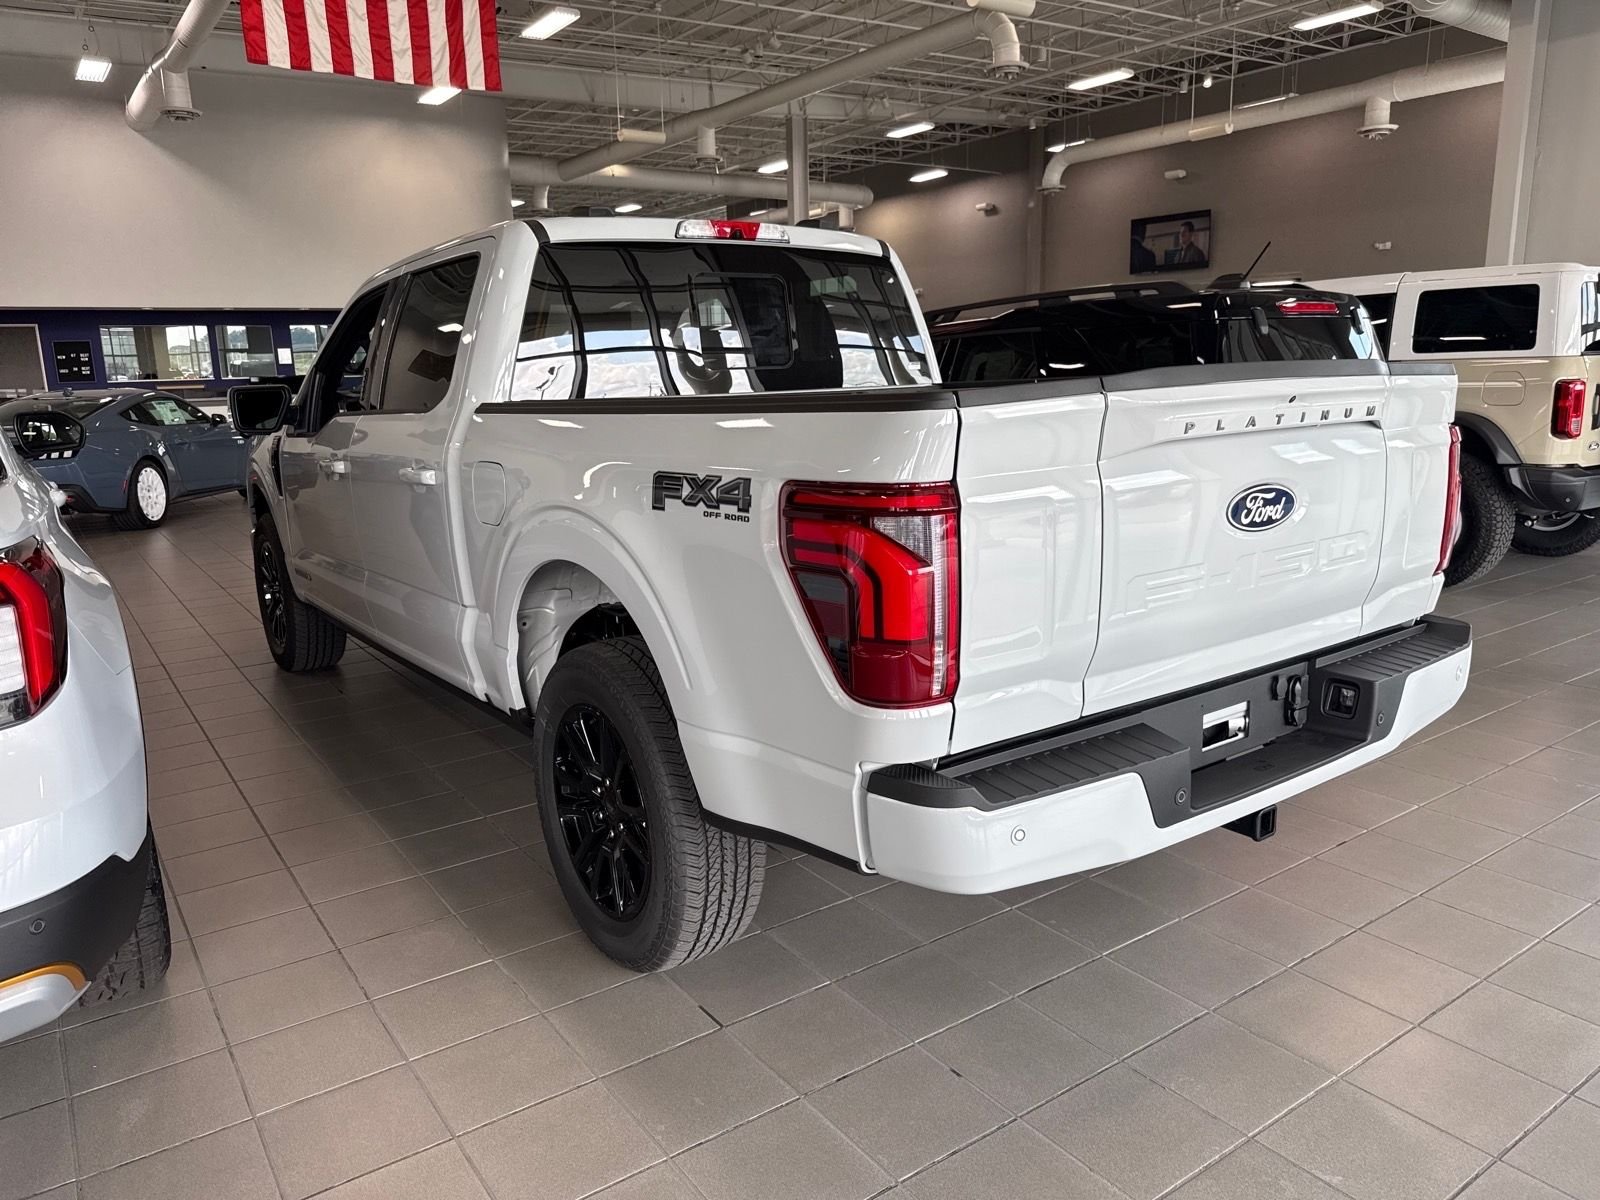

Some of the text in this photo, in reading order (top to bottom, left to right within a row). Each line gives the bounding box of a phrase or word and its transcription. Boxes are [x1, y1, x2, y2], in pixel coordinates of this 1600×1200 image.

[1183, 405, 1377, 435] PLATINUM
[652, 470, 752, 514] FX4
[703, 510, 750, 523] OFF ROAD
[1123, 530, 1369, 616] F-150
